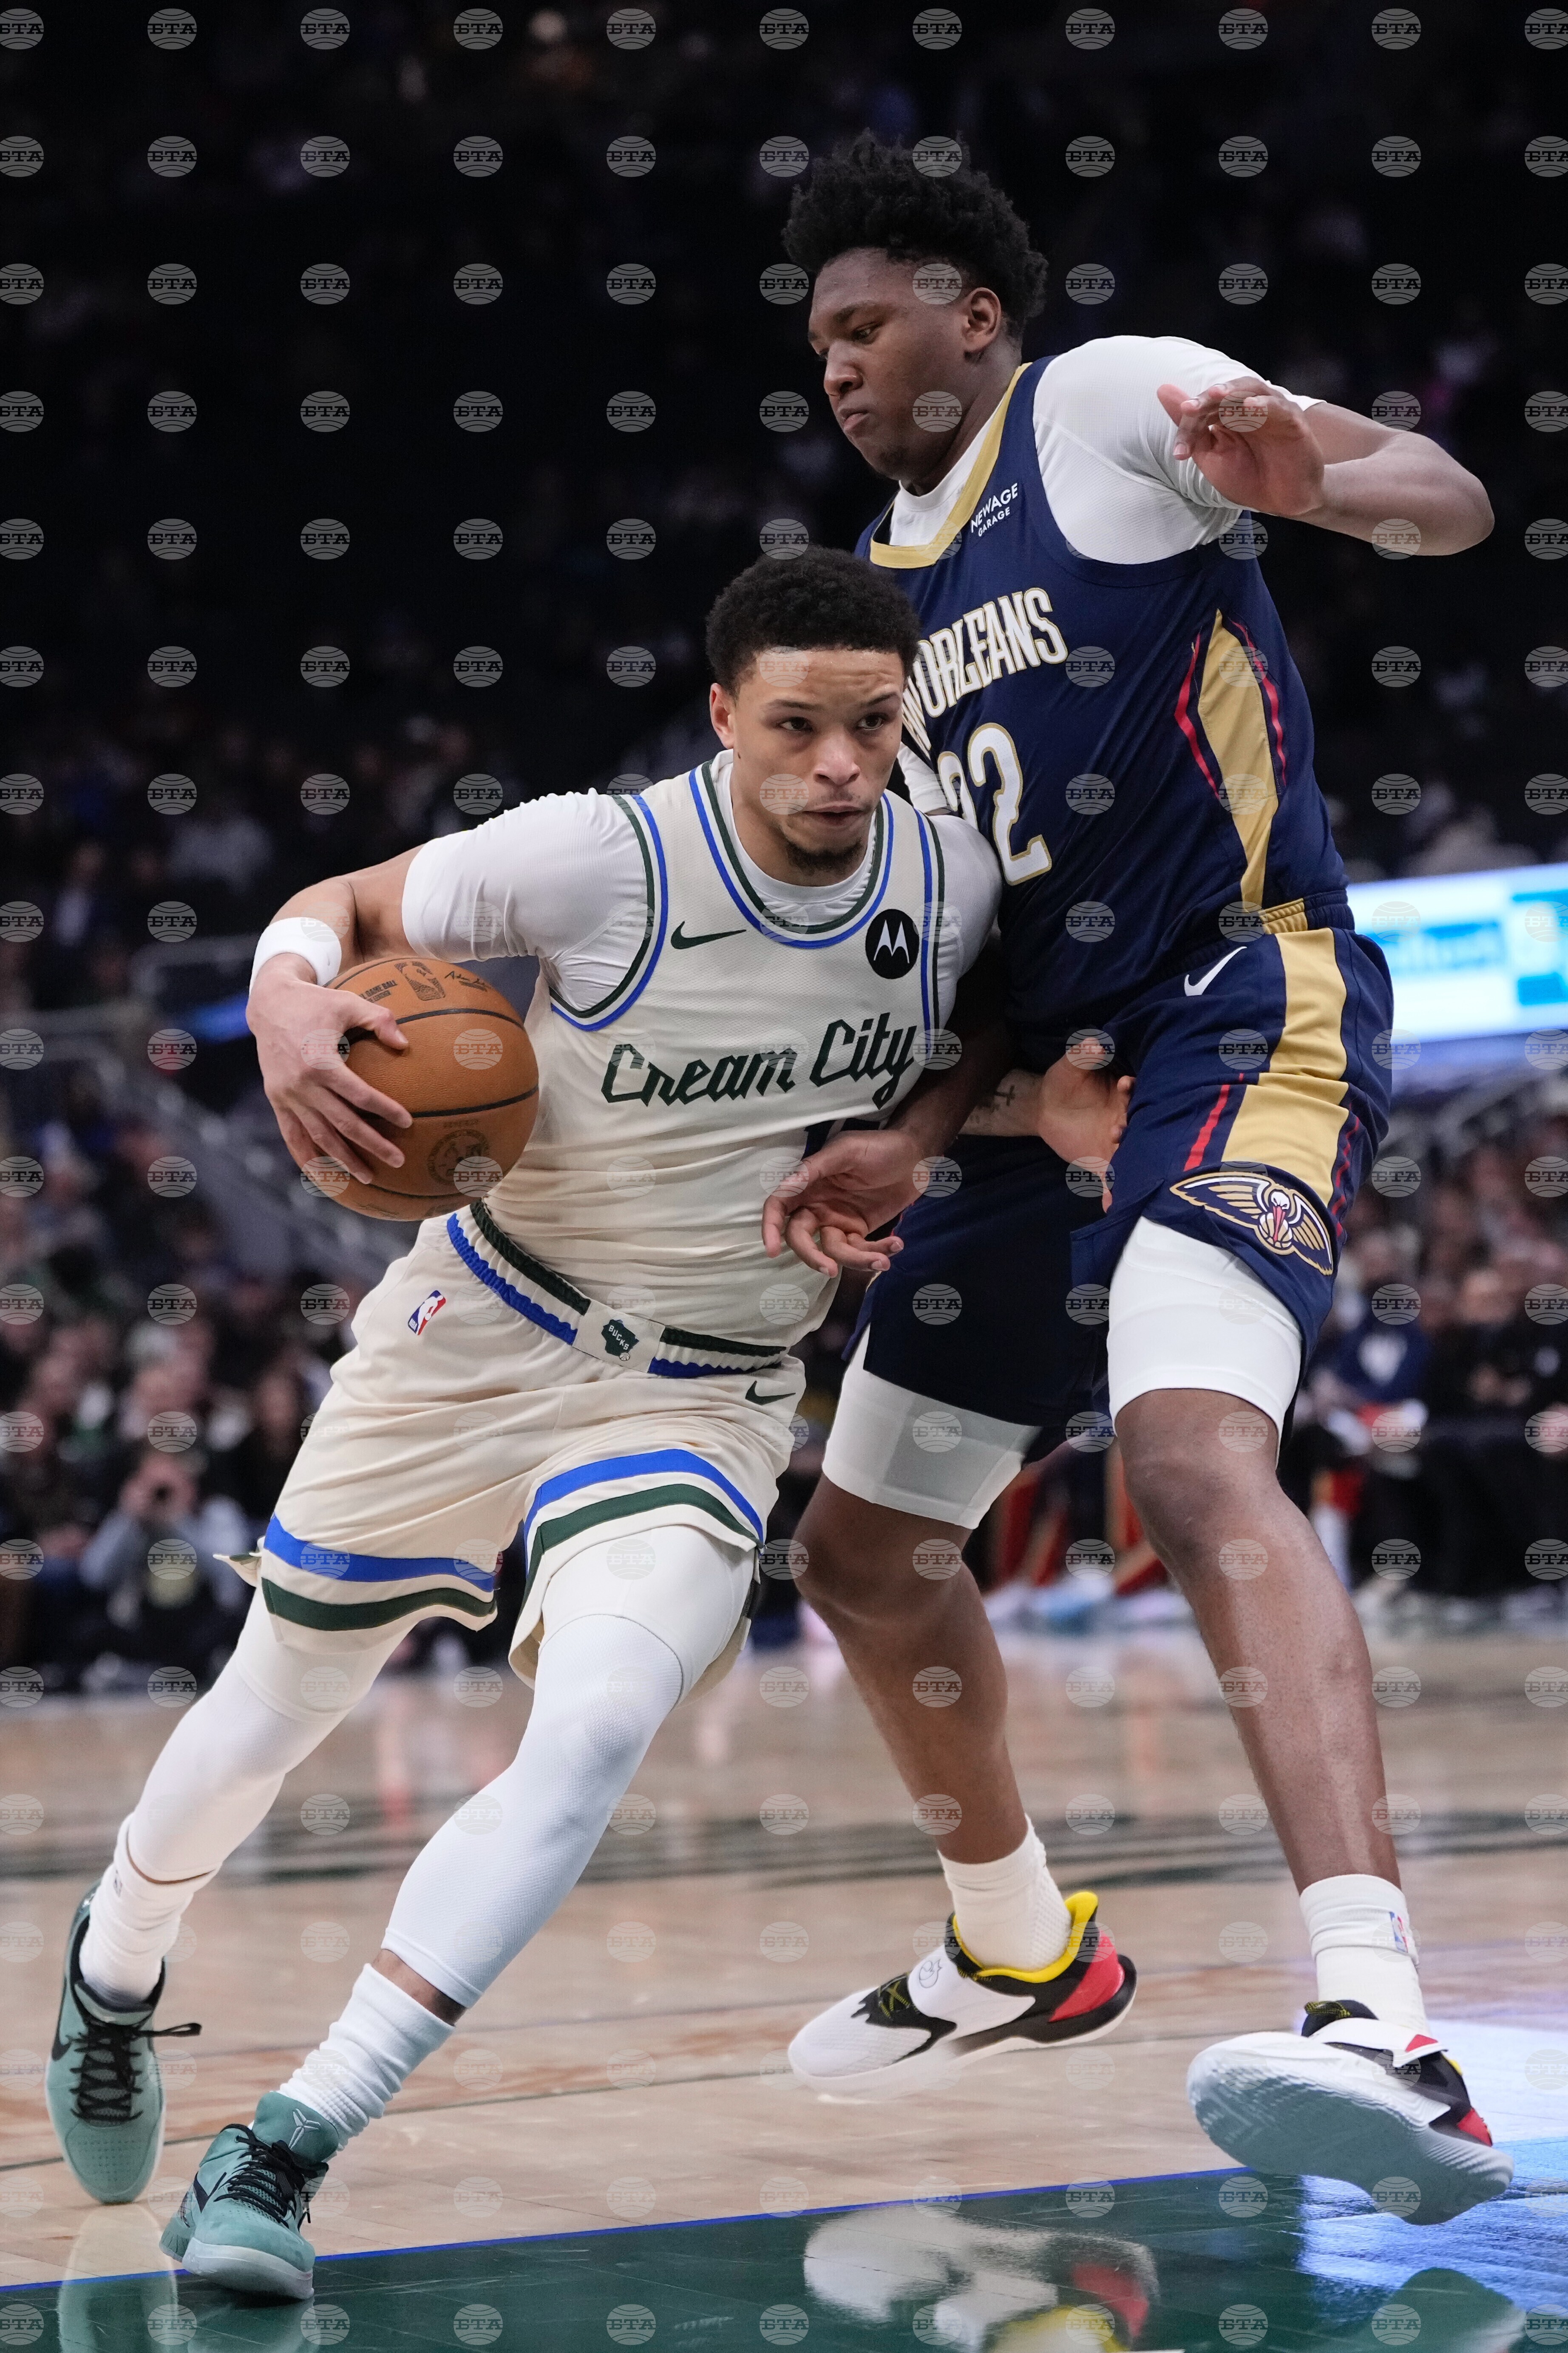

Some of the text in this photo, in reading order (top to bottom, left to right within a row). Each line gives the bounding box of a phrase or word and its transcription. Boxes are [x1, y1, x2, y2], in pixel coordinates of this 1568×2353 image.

[971, 483, 1018, 533] NEWAGE
[978, 507, 1010, 536] GARAGE
[913, 587, 1068, 718] ORLEANS
[601, 1012, 917, 1110] Cream City
[408, 1318, 418, 1331] NBA
[608, 1325, 629, 1350] BUCKS
